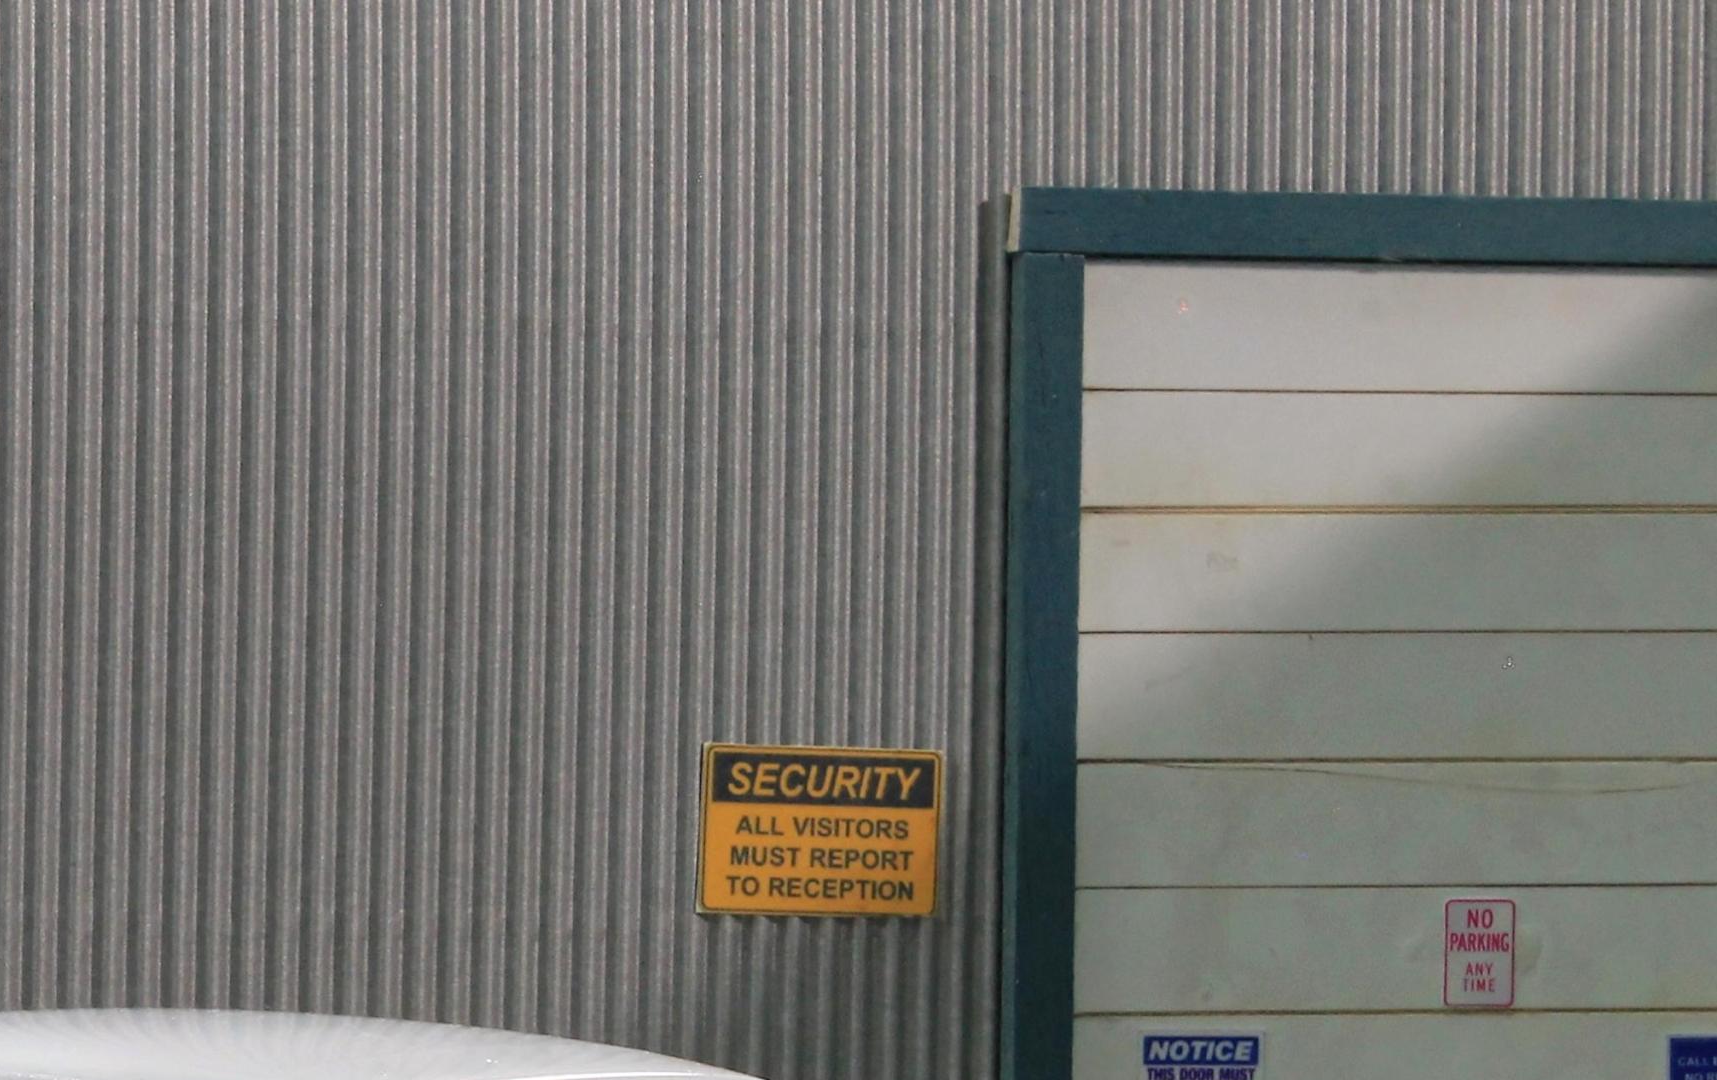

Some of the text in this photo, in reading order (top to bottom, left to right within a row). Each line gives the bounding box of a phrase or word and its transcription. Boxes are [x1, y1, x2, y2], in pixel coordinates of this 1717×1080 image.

[728, 761, 922, 800] SECURITY
[736, 816, 909, 840] ALL VISITORS
[730, 846, 914, 871] MUST REPORT
[726, 876, 914, 900] TO RECEPTION
[1467, 908, 1493, 929] NO
[1450, 932, 1510, 952] PARKING
[1466, 962, 1493, 976] ANY
[1149, 1040, 1254, 1061] NOTICE
[1147, 1068, 1255, 1080] THIS DOOR MUST
